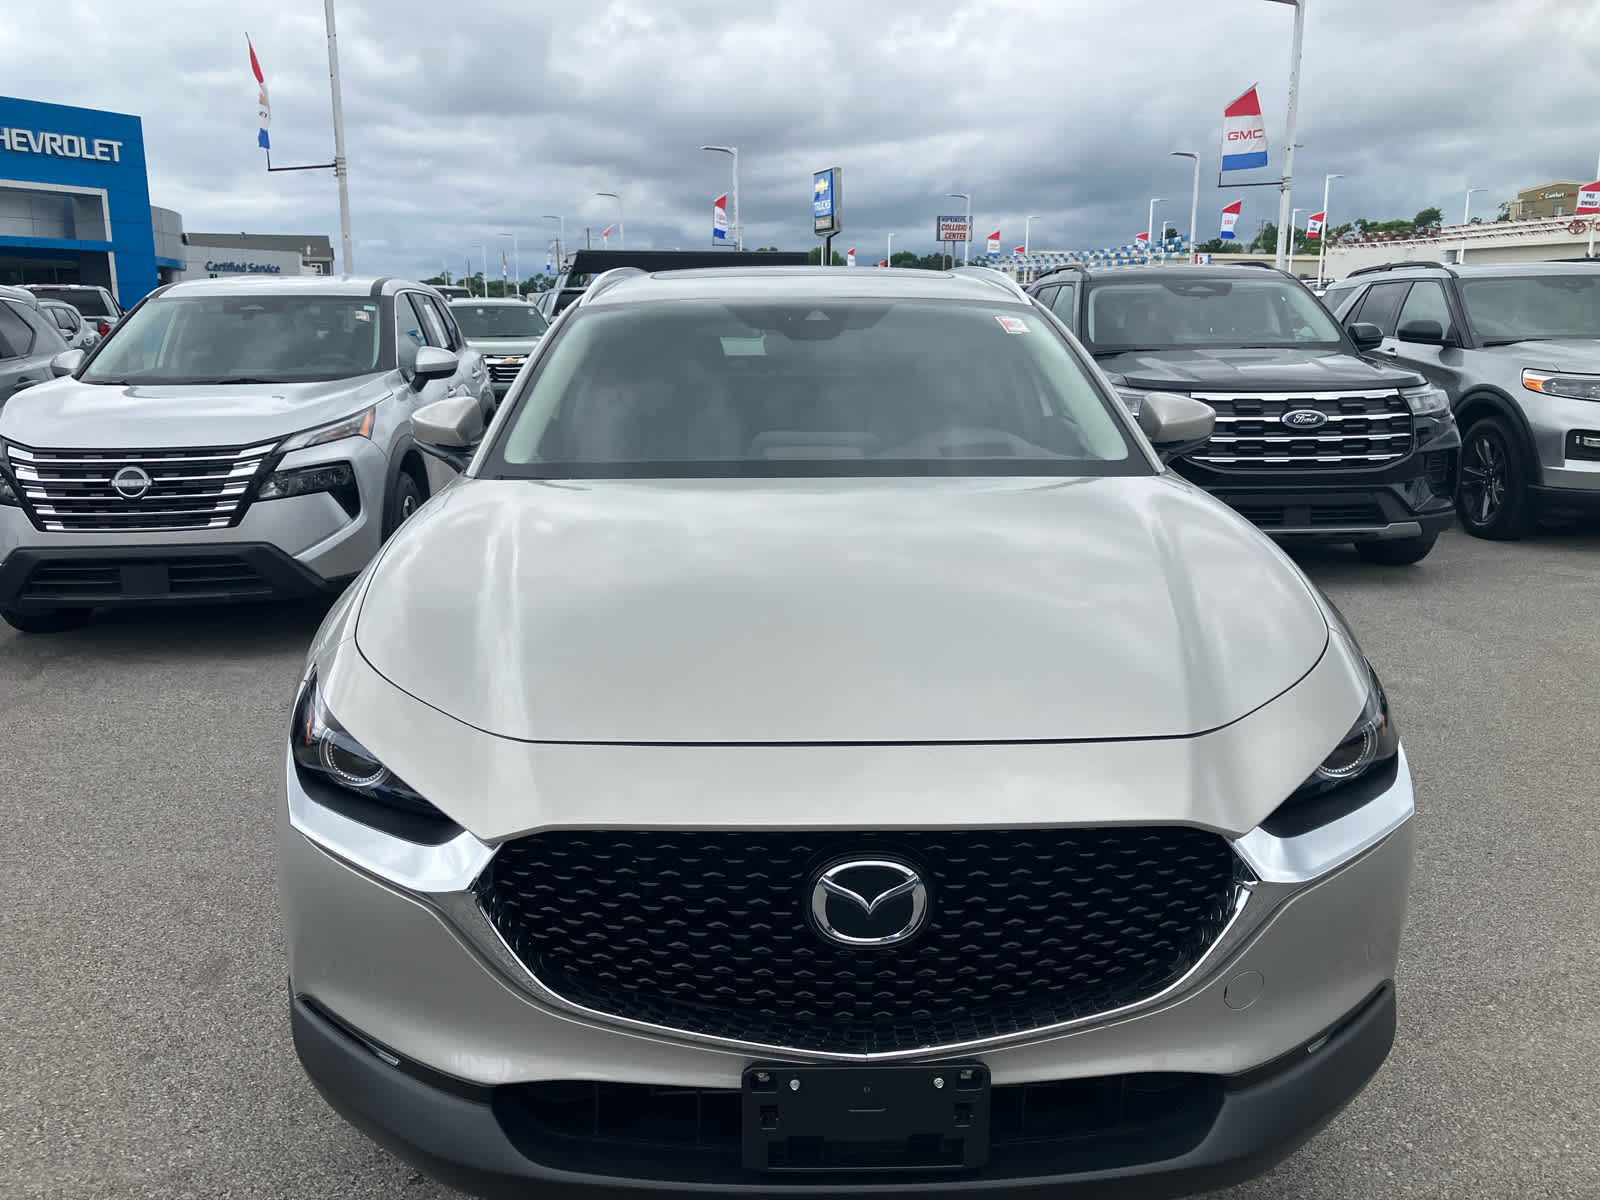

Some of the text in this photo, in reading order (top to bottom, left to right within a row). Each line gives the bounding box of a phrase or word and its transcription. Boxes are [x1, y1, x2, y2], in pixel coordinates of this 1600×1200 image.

[1227, 129, 1264, 141] GMC
[205, 260, 281, 274] Certified Service
[1293, 413, 1318, 424] Ford
